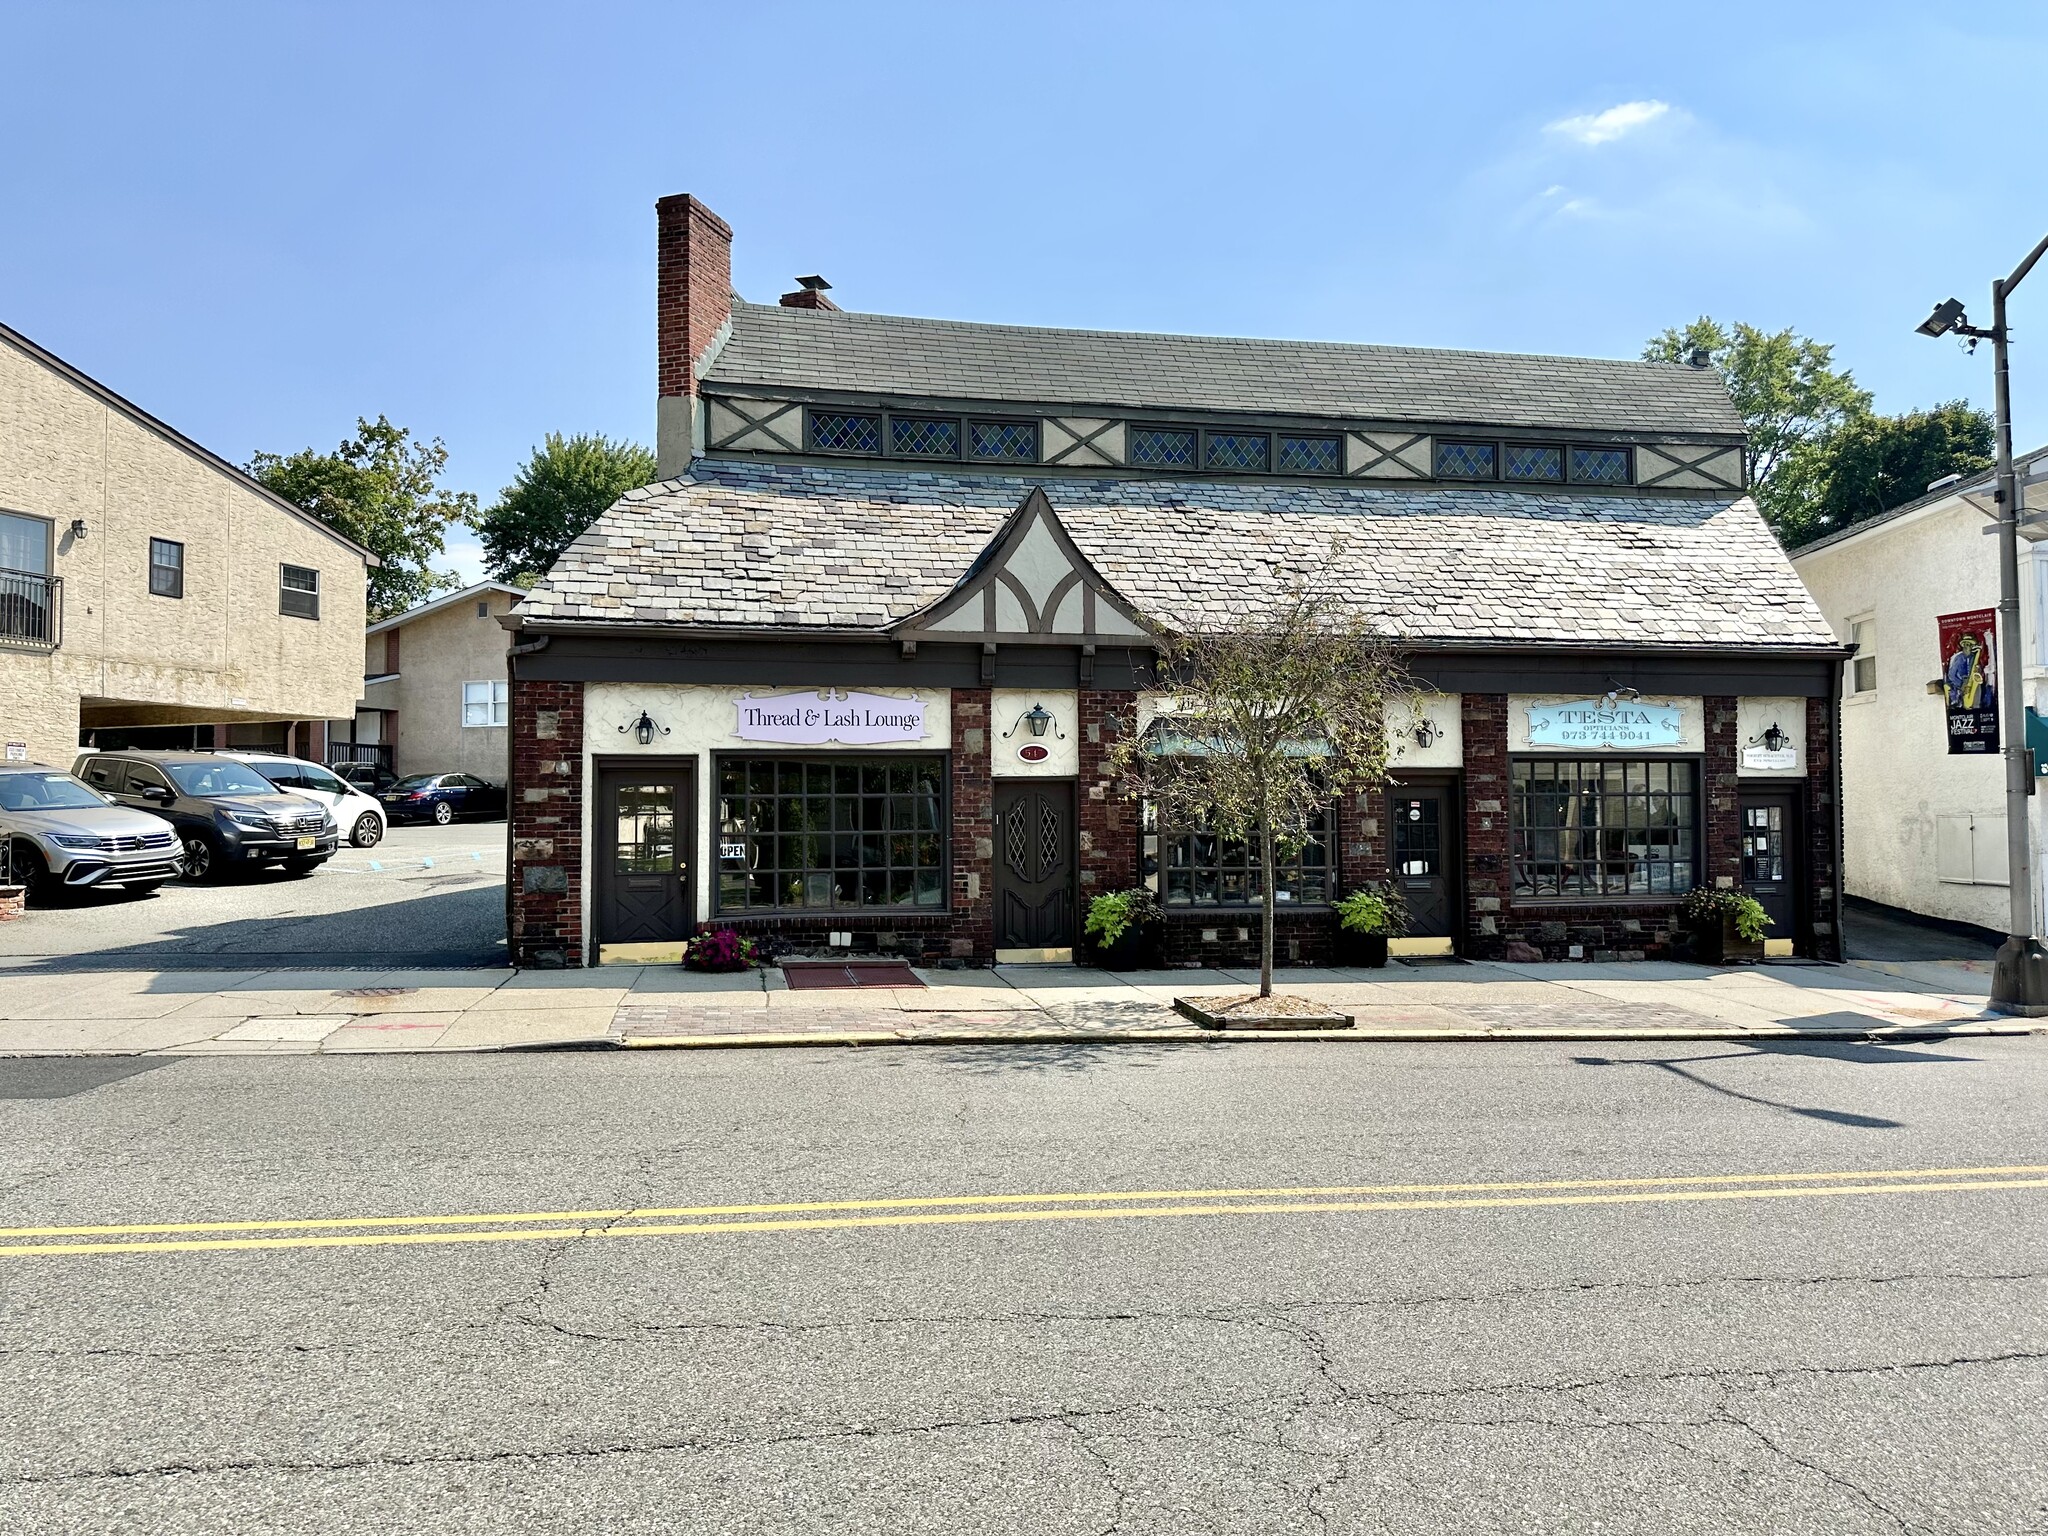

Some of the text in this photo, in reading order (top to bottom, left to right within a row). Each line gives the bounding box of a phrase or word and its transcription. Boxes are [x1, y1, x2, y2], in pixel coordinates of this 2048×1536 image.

[1941, 616, 1966, 624] DOWNTOWN
[1966, 612, 1992, 620] MONTCLAIR
[744, 708, 920, 732] Thread & Lash Lounge
[1558, 711, 1652, 724] TESTA
[1950, 719, 1975, 730] JAZZ
[1562, 731, 1651, 740] 973-744-9041
[1950, 728, 1975, 736] FESTIVAL
[720, 845, 746, 857] OPEN
